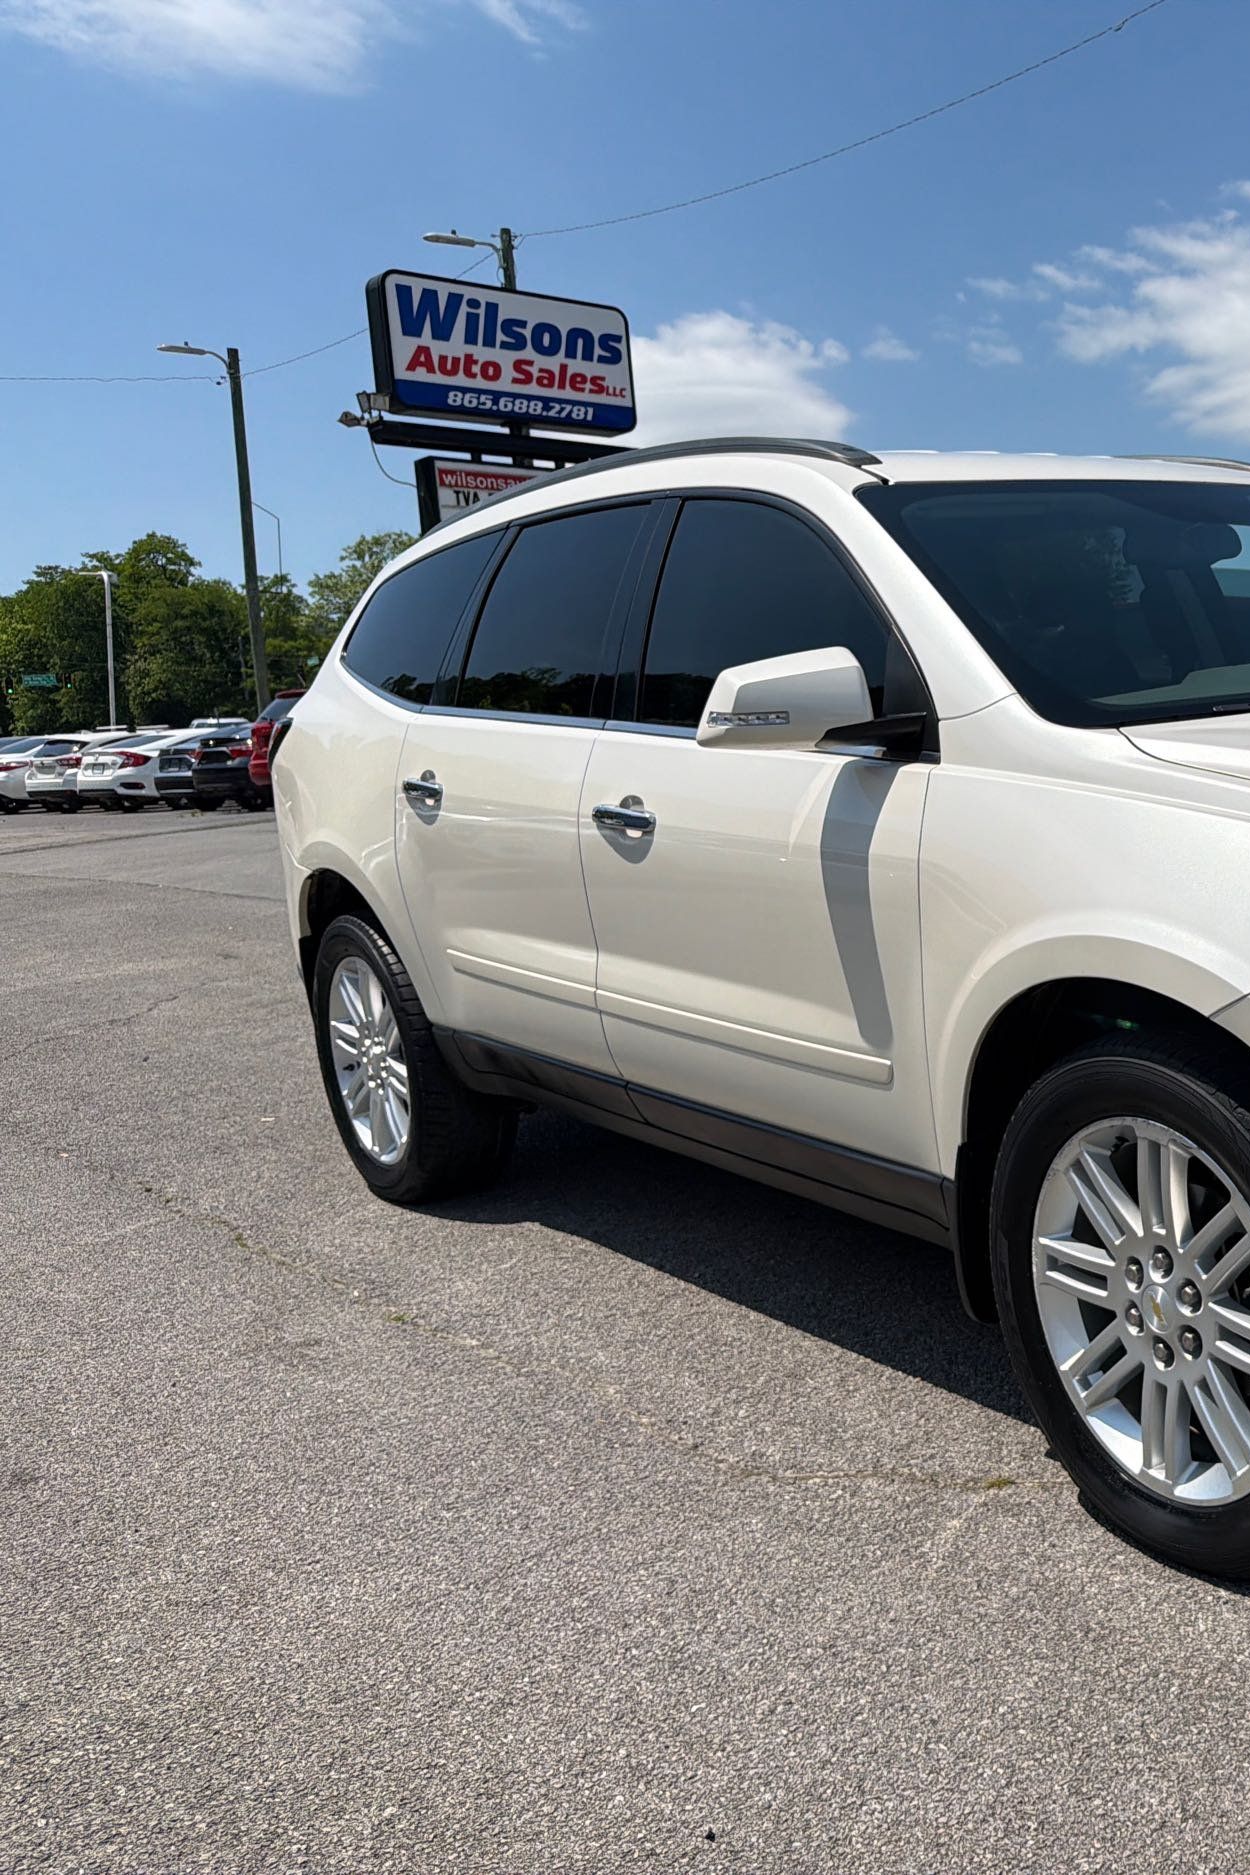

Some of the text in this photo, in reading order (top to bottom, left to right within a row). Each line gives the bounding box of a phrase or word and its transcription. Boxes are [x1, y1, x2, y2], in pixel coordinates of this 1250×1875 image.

[394, 283, 623, 365] Wilsons
[405, 345, 626, 399] Auto Sales LLC
[447, 390, 594, 421] 865.688.2781
